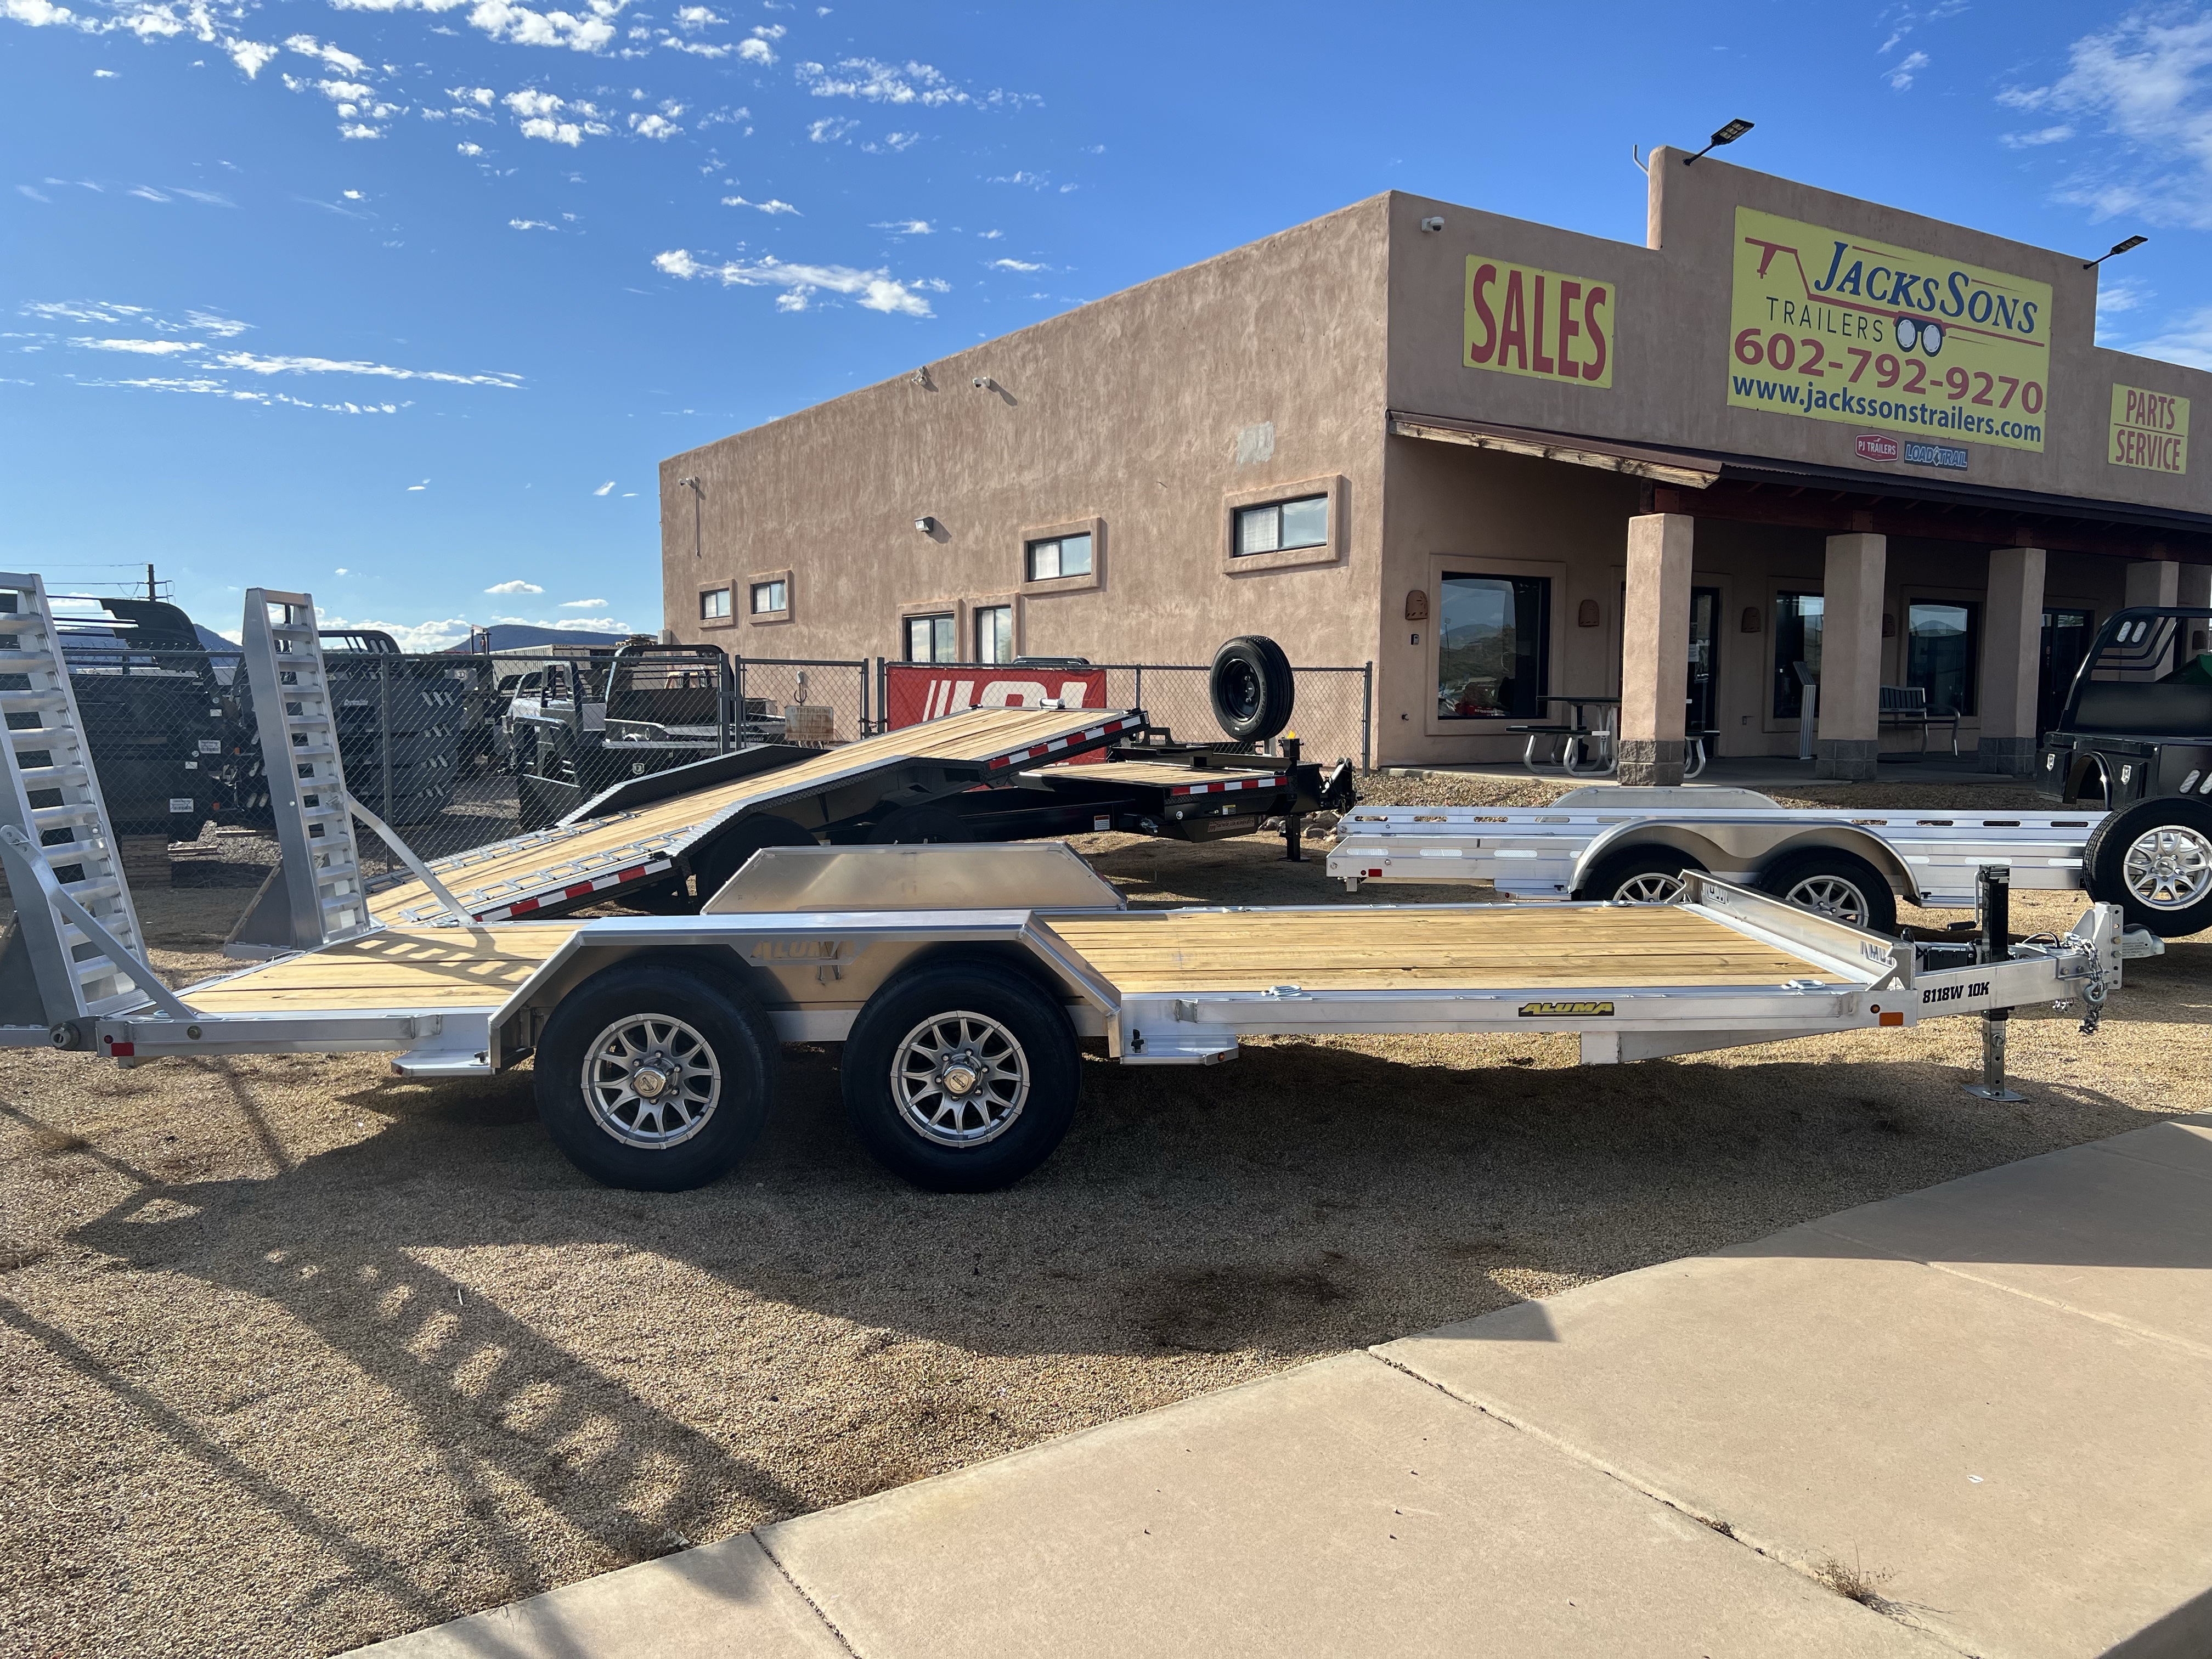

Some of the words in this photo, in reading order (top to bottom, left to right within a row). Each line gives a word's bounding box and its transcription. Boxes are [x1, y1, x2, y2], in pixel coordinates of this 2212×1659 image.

[1471, 264, 1606, 381] SALES
[1766, 296, 1883, 343] TRAILERS
[1734, 328, 2043, 414] 602-792-9270
[1733, 375, 2041, 443] www.jackssonstrailers.com
[2126, 390, 2175, 430] PARTS
[1858, 441, 1865, 451] PJ
[1866, 442, 1896, 455] TRAILERS
[2115, 429, 2181, 471] SERVICE
[751, 941, 855, 960] ALUMA
[1520, 1003, 1613, 1015] ALUMA
[1923, 985, 1964, 1003] 8118W
[1968, 981, 1990, 997] 10K
